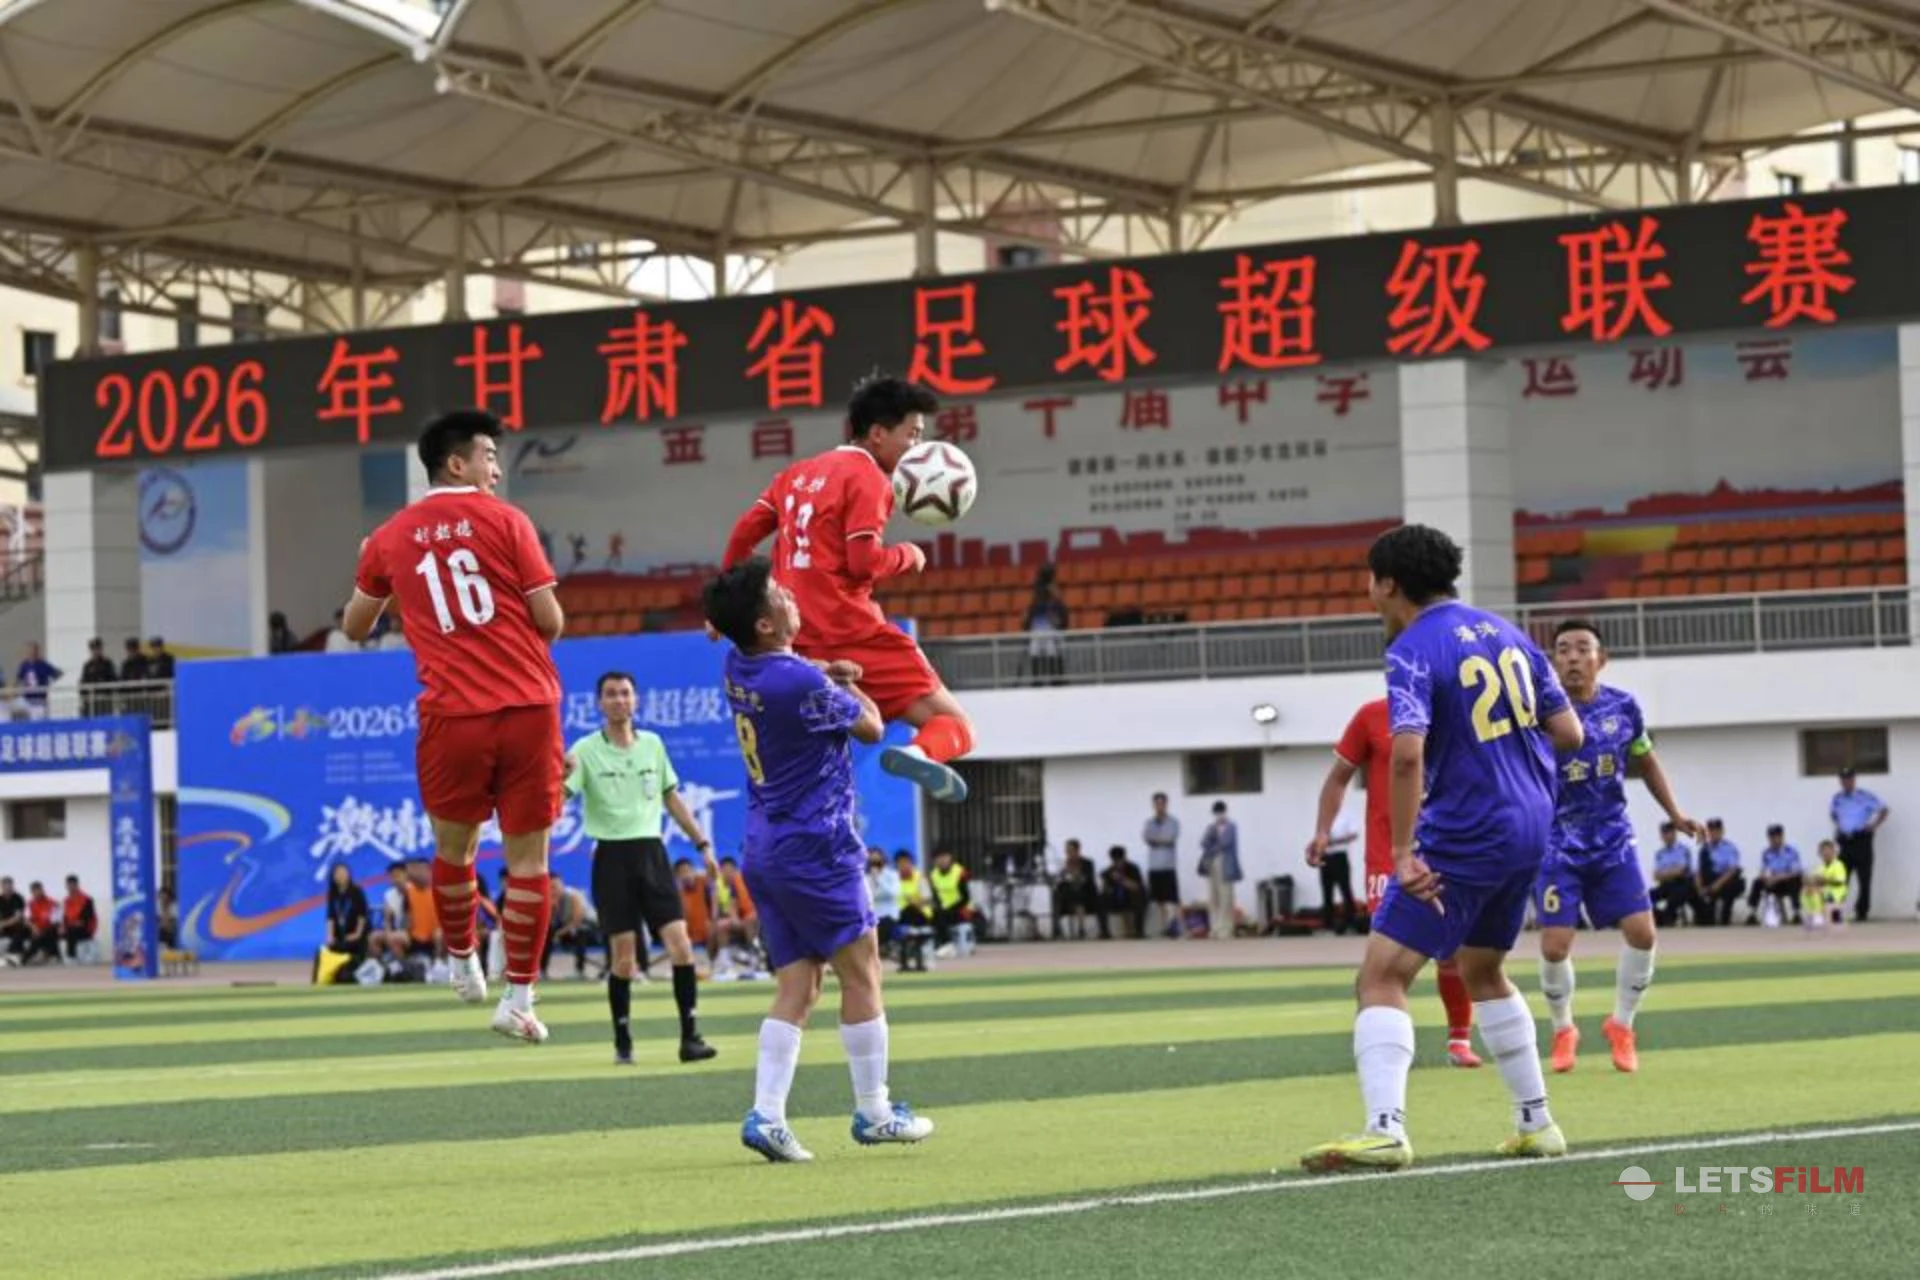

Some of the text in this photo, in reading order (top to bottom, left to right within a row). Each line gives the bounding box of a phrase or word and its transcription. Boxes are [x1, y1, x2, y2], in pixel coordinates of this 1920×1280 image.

[94, 204, 1855, 457] 2026年甘肃省足球超级联赛
[415, 547, 495, 634] 16
[1459, 644, 1540, 743] 20
[1543, 884, 1561, 913] 6
